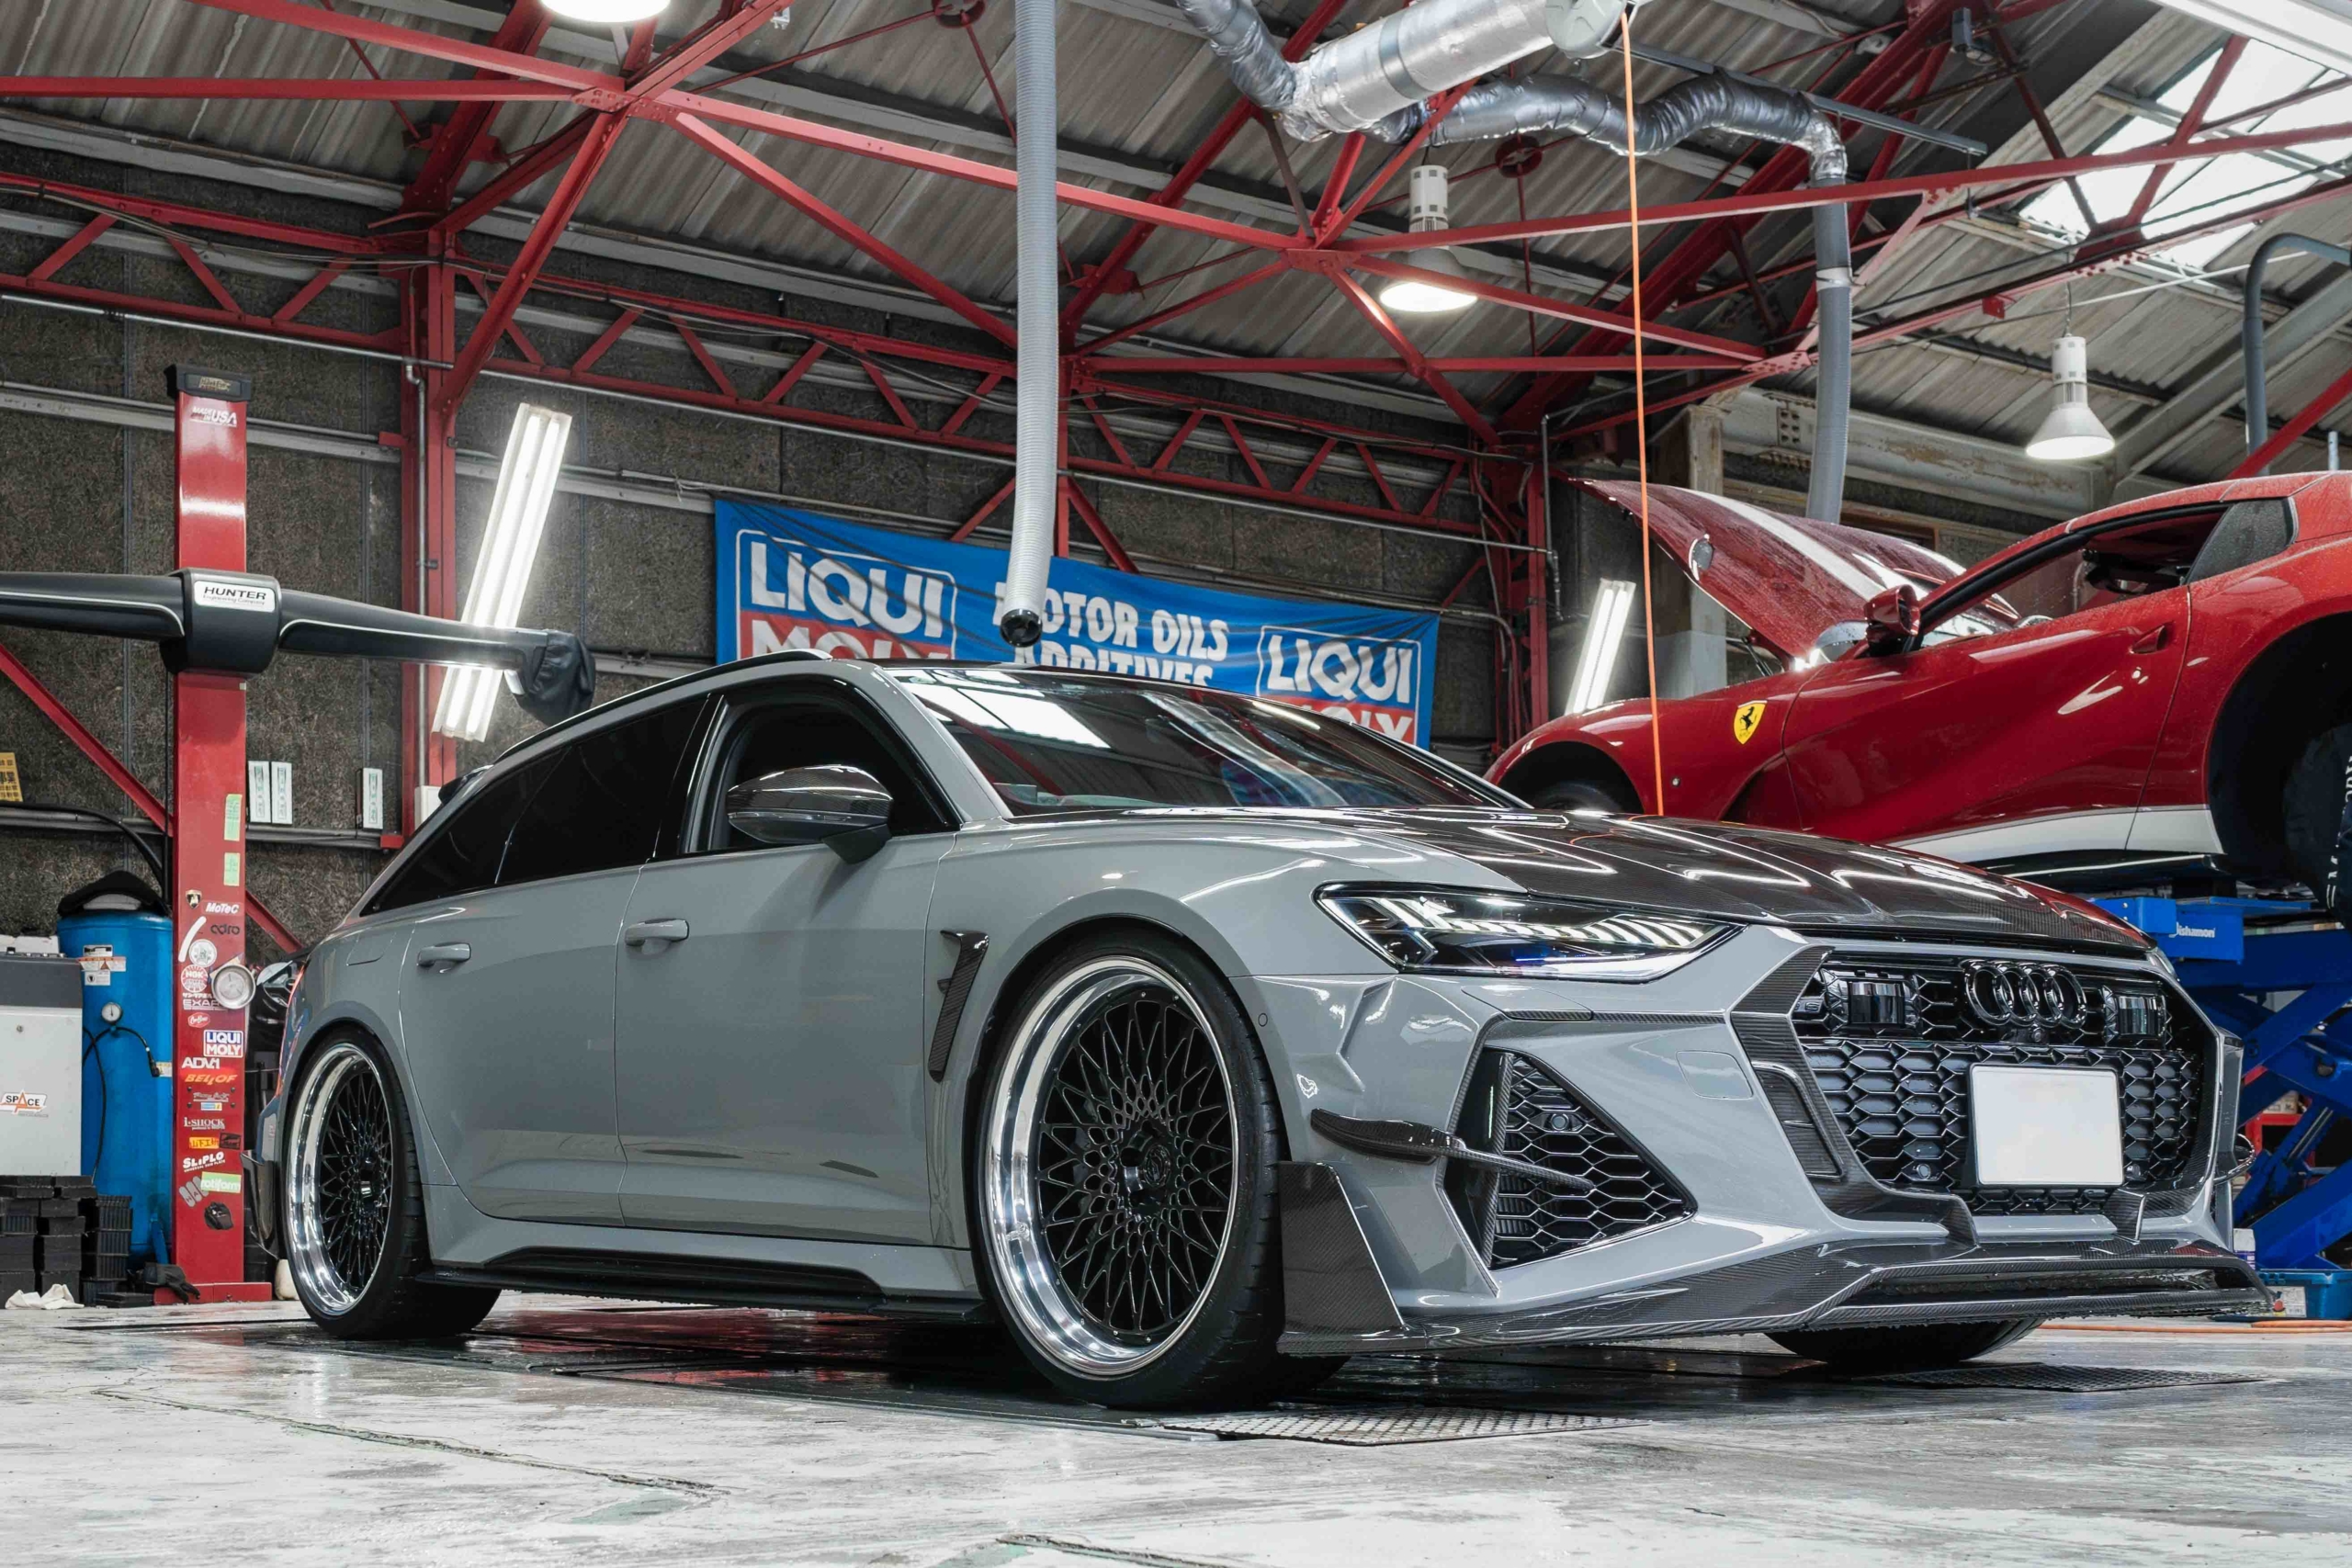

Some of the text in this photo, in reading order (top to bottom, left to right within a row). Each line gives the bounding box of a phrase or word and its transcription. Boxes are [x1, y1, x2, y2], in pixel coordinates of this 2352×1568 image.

[211, 410, 237, 425] USA
[204, 586, 266, 600] HUNTER
[751, 541, 944, 638] LIQUI
[1151, 609, 1229, 661] OILS
[1267, 635, 1413, 704] LIQUI
[207, 1032, 242, 1044] LIQUI
[206, 1043, 242, 1056] MOLY
[6, 1092, 40, 1108] SPACE
